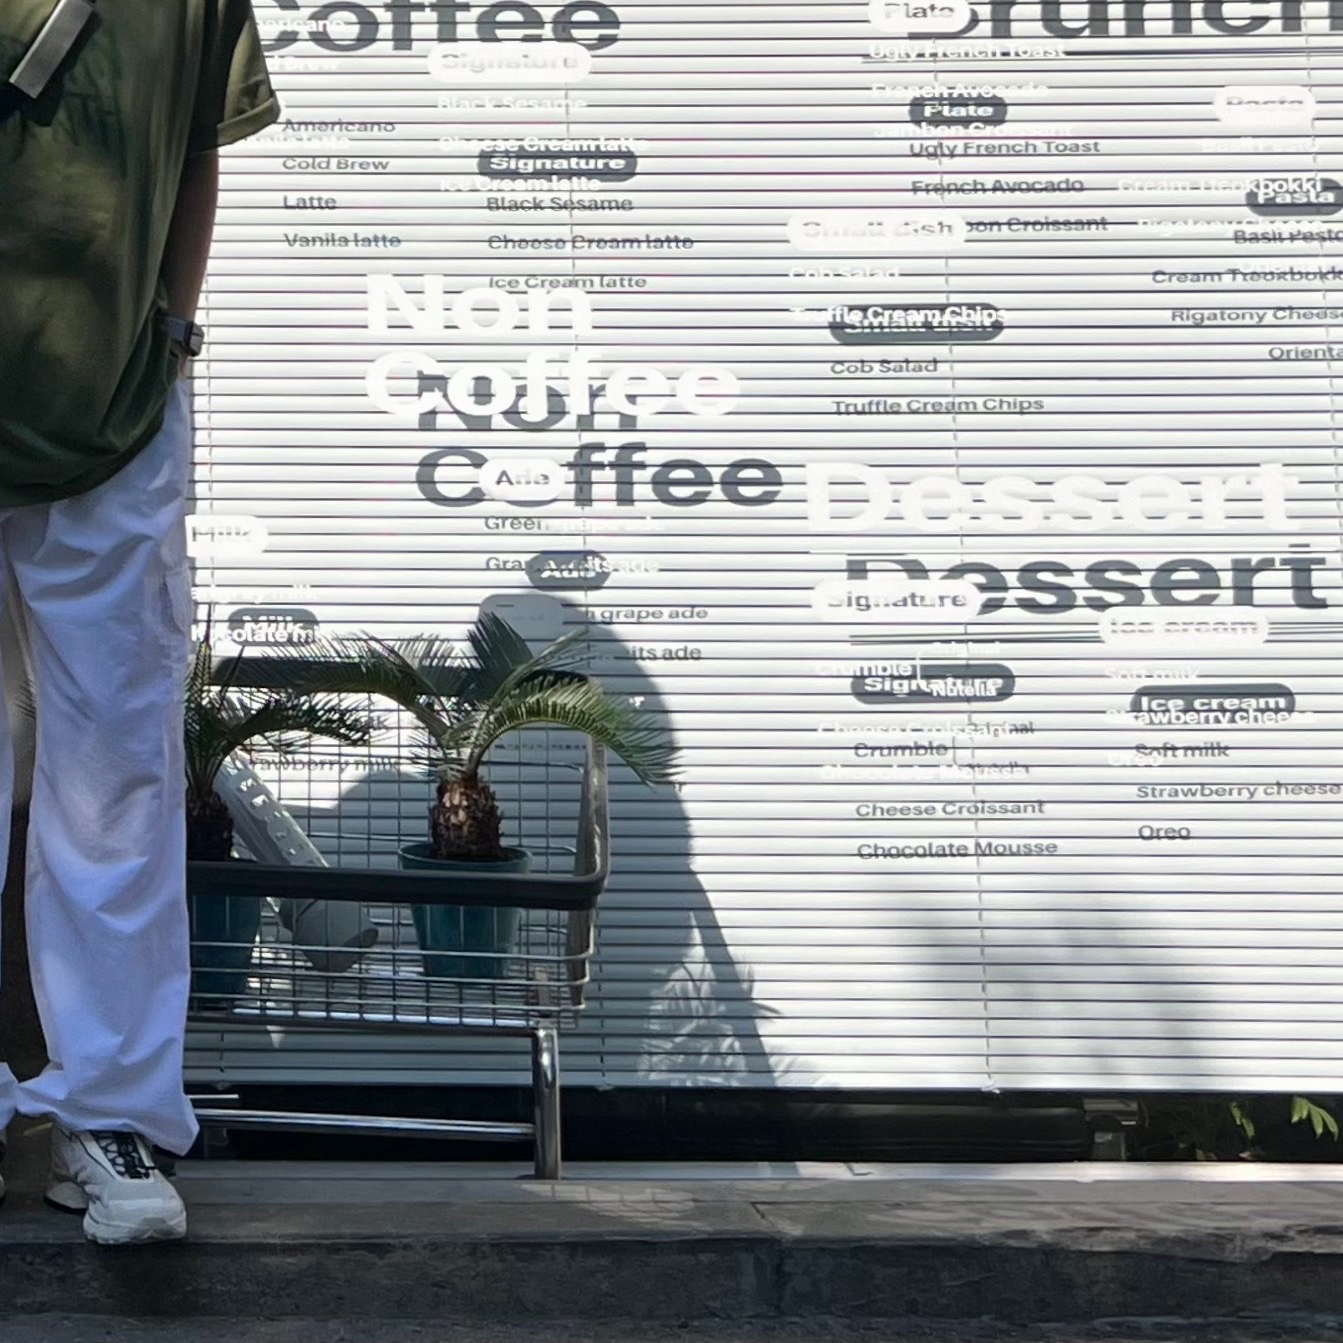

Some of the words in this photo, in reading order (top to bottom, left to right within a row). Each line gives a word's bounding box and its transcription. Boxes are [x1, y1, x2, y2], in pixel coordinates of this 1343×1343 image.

[923, 101, 994, 118] Plate
[281, 118, 397, 134] Americano
[909, 142, 958, 160] Ugly
[963, 140, 1038, 154] French
[1043, 139, 1101, 153] Toast
[281, 157, 331, 171] Cold
[336, 157, 391, 171] Brew
[489, 154, 627, 174] Signature
[911, 179, 986, 196] French
[991, 177, 1085, 194] Avocado
[282, 195, 338, 211] Latte
[486, 196, 546, 212] Black
[550, 196, 634, 212] Sesame
[1259, 189, 1336, 205] Pasta
[1006, 216, 1110, 233] Croissant
[284, 232, 349, 249] Vanila
[353, 232, 403, 249] latte
[487, 234, 567, 251] Cheese
[571, 234, 641, 250] Cream
[645, 233, 695, 250] latte
[488, 275, 520, 289] Ice
[524, 275, 594, 290] Cream
[599, 274, 648, 289] latte
[1152, 269, 1223, 284] Cream
[366, 274, 593, 336] Non
[867, 306, 941, 323] Cream
[1171, 310, 1268, 325] Rigatony
[830, 358, 874, 374] Cob
[879, 357, 939, 373] Salad
[365, 351, 741, 417] Coffee
[832, 399, 902, 415] Truffle
[907, 398, 978, 413] Cream
[982, 397, 1045, 414] Chips
[415, 442, 784, 508] Cffee
[804, 462, 1300, 534] Dessert
[600, 607, 663, 626] grape
[668, 604, 709, 620] ade
[661, 645, 703, 662] ade
[1141, 696, 1185, 711] Ice
[1193, 696, 1287, 711] cream
[853, 740, 950, 758] Crumble
[1183, 741, 1230, 758] milk
[1136, 783, 1259, 800] Strawberry
[1263, 780, 1342, 797] cheese
[855, 803, 937, 818] Cheese
[941, 799, 1046, 816] Croissant
[1137, 824, 1192, 841] Oreo
[857, 842, 969, 860] Chocolate
[974, 840, 1059, 856] Mousse
